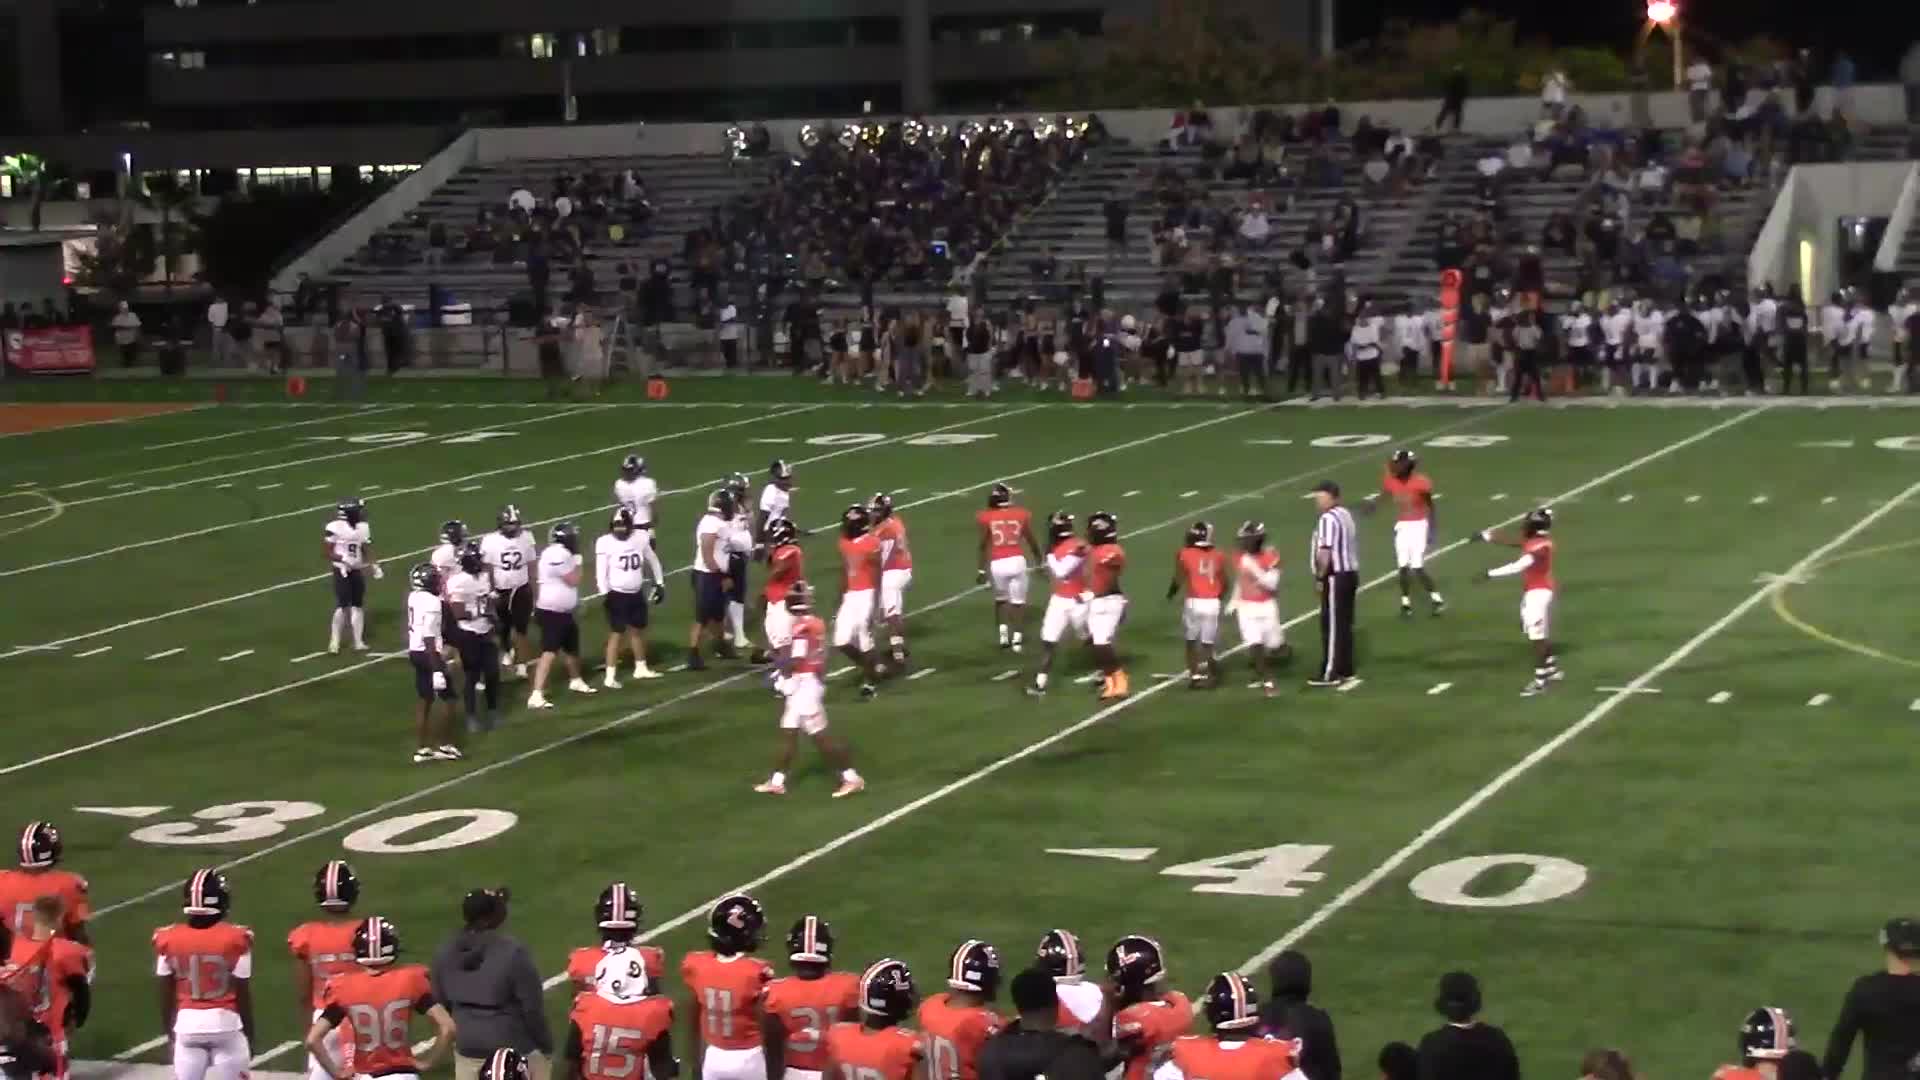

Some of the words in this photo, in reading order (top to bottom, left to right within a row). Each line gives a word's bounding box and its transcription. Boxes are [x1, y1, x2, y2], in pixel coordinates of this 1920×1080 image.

[500, 551, 523, 571] 52
[130, 801, 518, 853] 30
[1159, 843, 1589, 907] 40
[705, 987, 734, 1038] 11
[587, 1023, 642, 1078] 15
